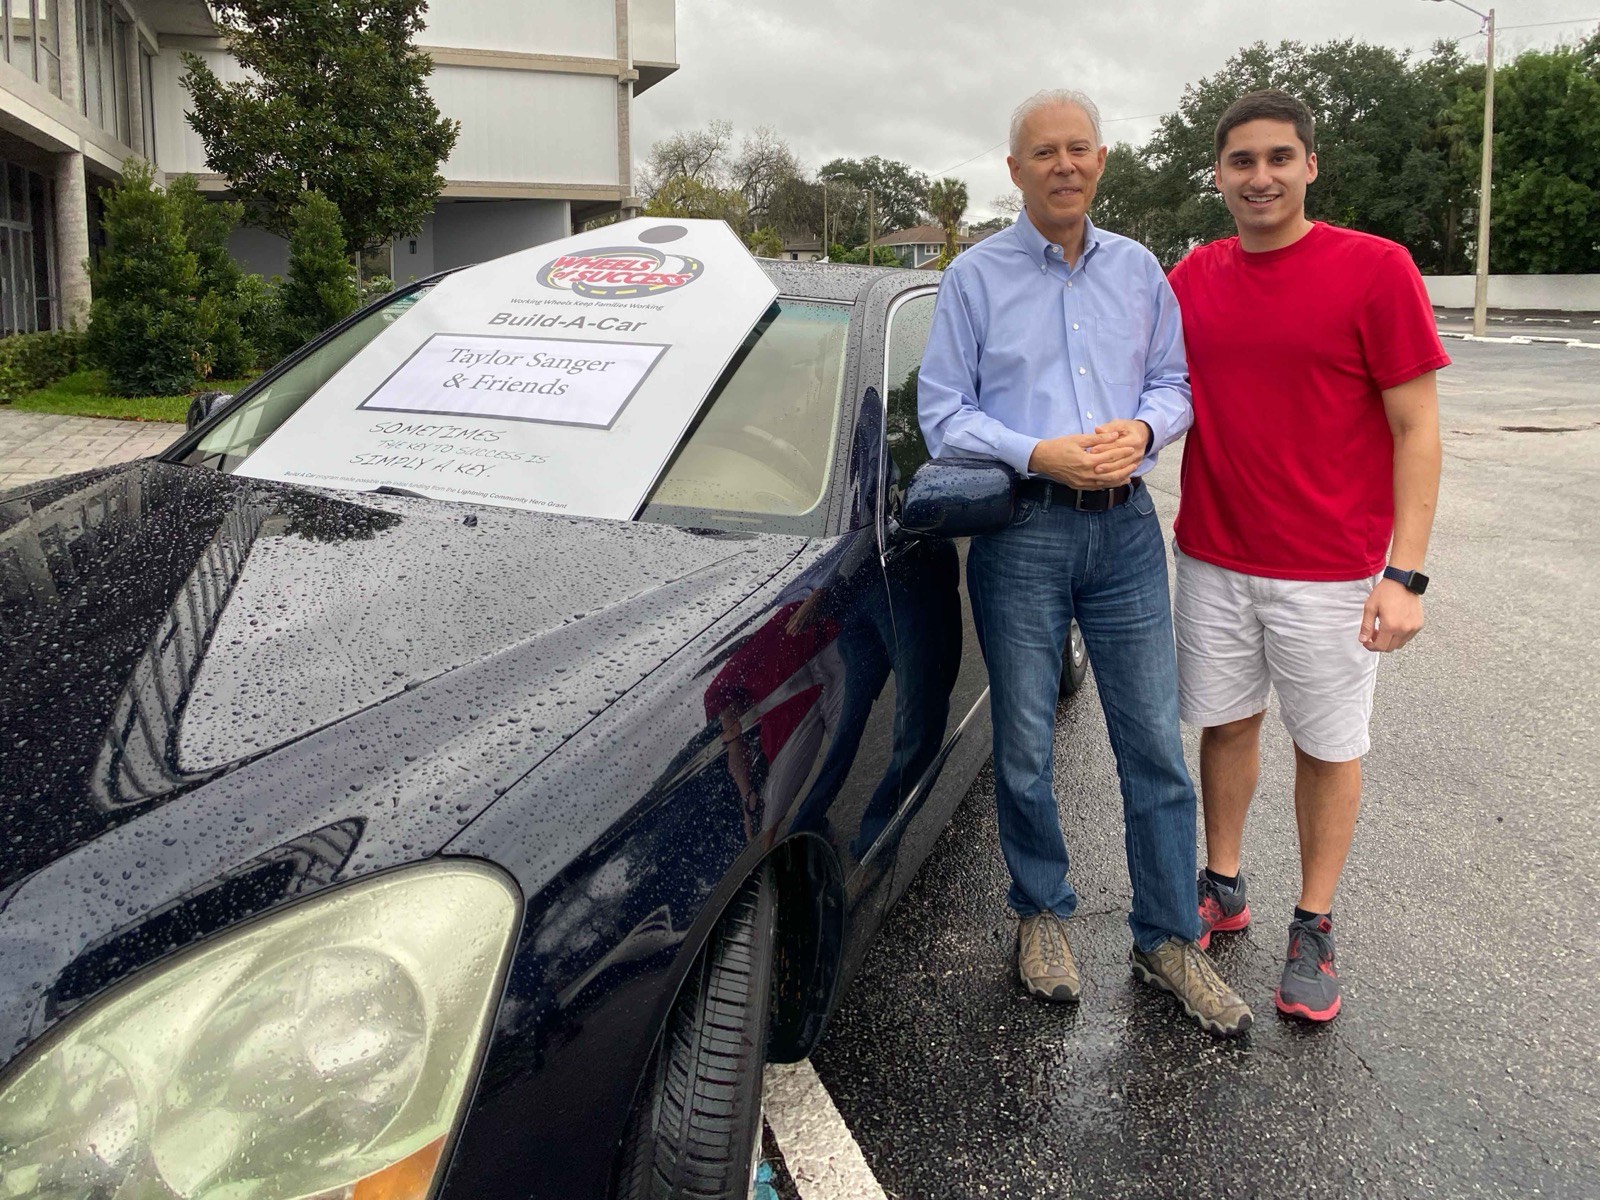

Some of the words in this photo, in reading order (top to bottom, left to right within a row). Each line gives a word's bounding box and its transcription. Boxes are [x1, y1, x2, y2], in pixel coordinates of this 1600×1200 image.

[552, 256, 659, 271] WHEELS
[552, 270, 575, 281] of
[570, 271, 692, 287] SUCCESS
[510, 298, 543, 306] Working
[594, 301, 628, 309] Families
[629, 303, 665, 311] Working
[487, 312, 647, 332] Build-A-Car
[446, 347, 524, 369] Taylor
[526, 352, 616, 375] Sanger
[442, 372, 470, 389] &
[469, 374, 570, 396] Friends
[369, 422, 507, 442] SOMETIMES
[378, 440, 407, 449] THE
[408, 441, 431, 451] KEY
[431, 443, 454, 453] TO
[455, 447, 523, 461] SUCCESS
[525, 454, 551, 464] IS
[350, 453, 435, 471] SIMPLY
[432, 459, 454, 473] A
[454, 463, 497, 478] KEY.
[456, 488, 489, 498] Lightning
[489, 492, 529, 503] Community
[528, 498, 546, 506] Hero
[547, 501, 568, 509] Grant
